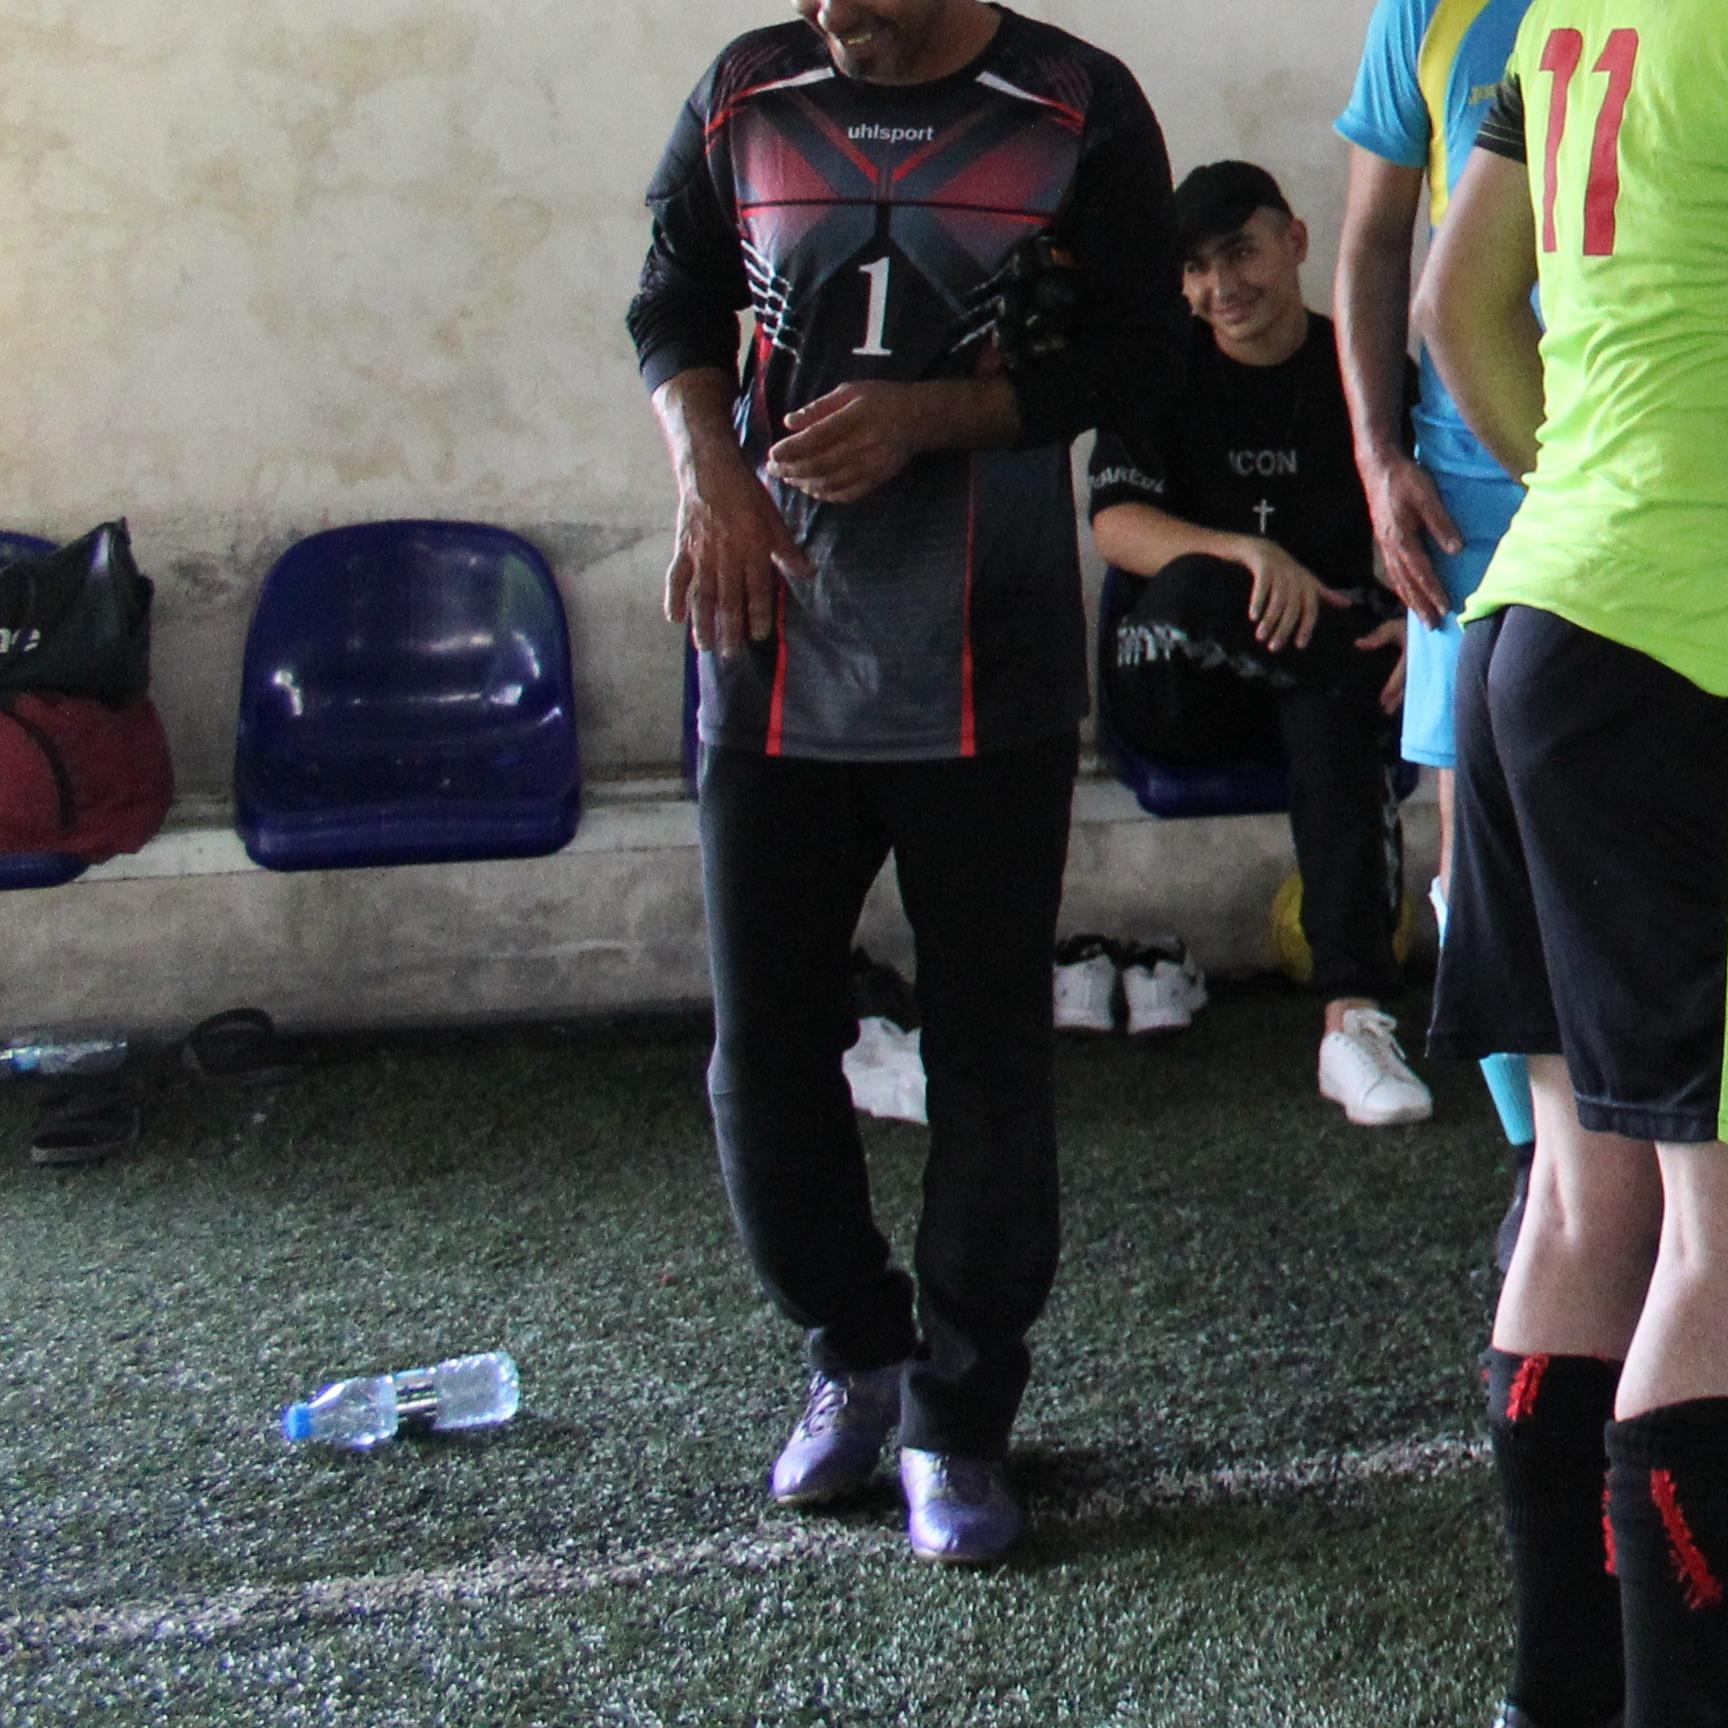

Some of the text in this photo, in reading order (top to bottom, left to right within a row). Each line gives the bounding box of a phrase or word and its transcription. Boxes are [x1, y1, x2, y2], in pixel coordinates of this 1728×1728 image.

[847, 123, 935, 144] uhlsport
[1538, 28, 1639, 256] 11
[852, 256, 892, 356] 1
